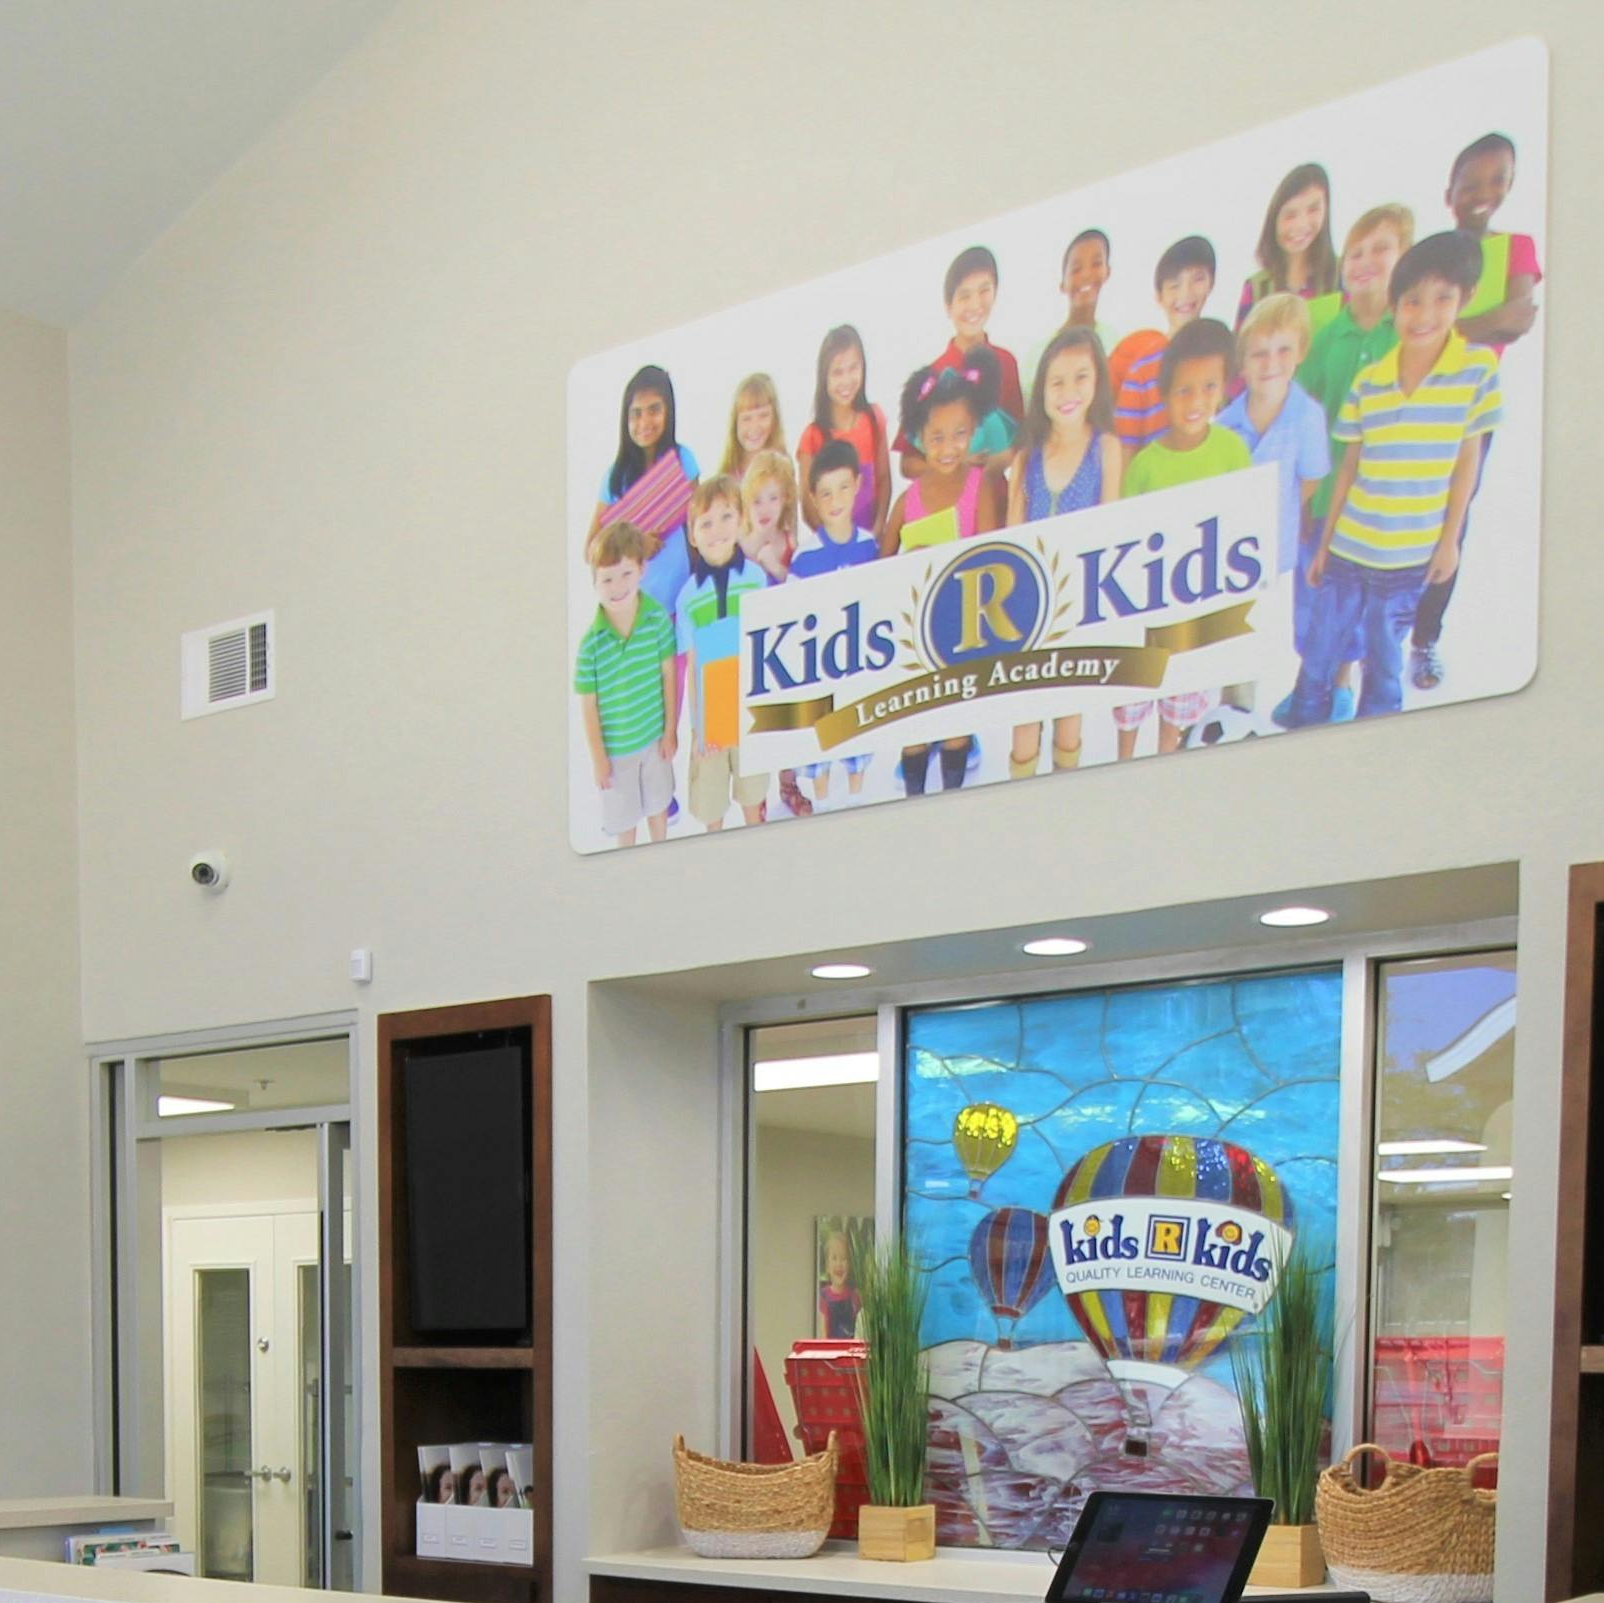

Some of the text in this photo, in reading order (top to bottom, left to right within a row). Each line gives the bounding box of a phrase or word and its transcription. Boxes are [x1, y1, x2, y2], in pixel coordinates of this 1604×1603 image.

[747, 515, 1262, 698] Kids R Kids
[856, 655, 1121, 728] Learning Academy
[1059, 1213, 1273, 1282] kids R kids
[1065, 1265, 1257, 1300] QUALITY LEARNING CENTER
